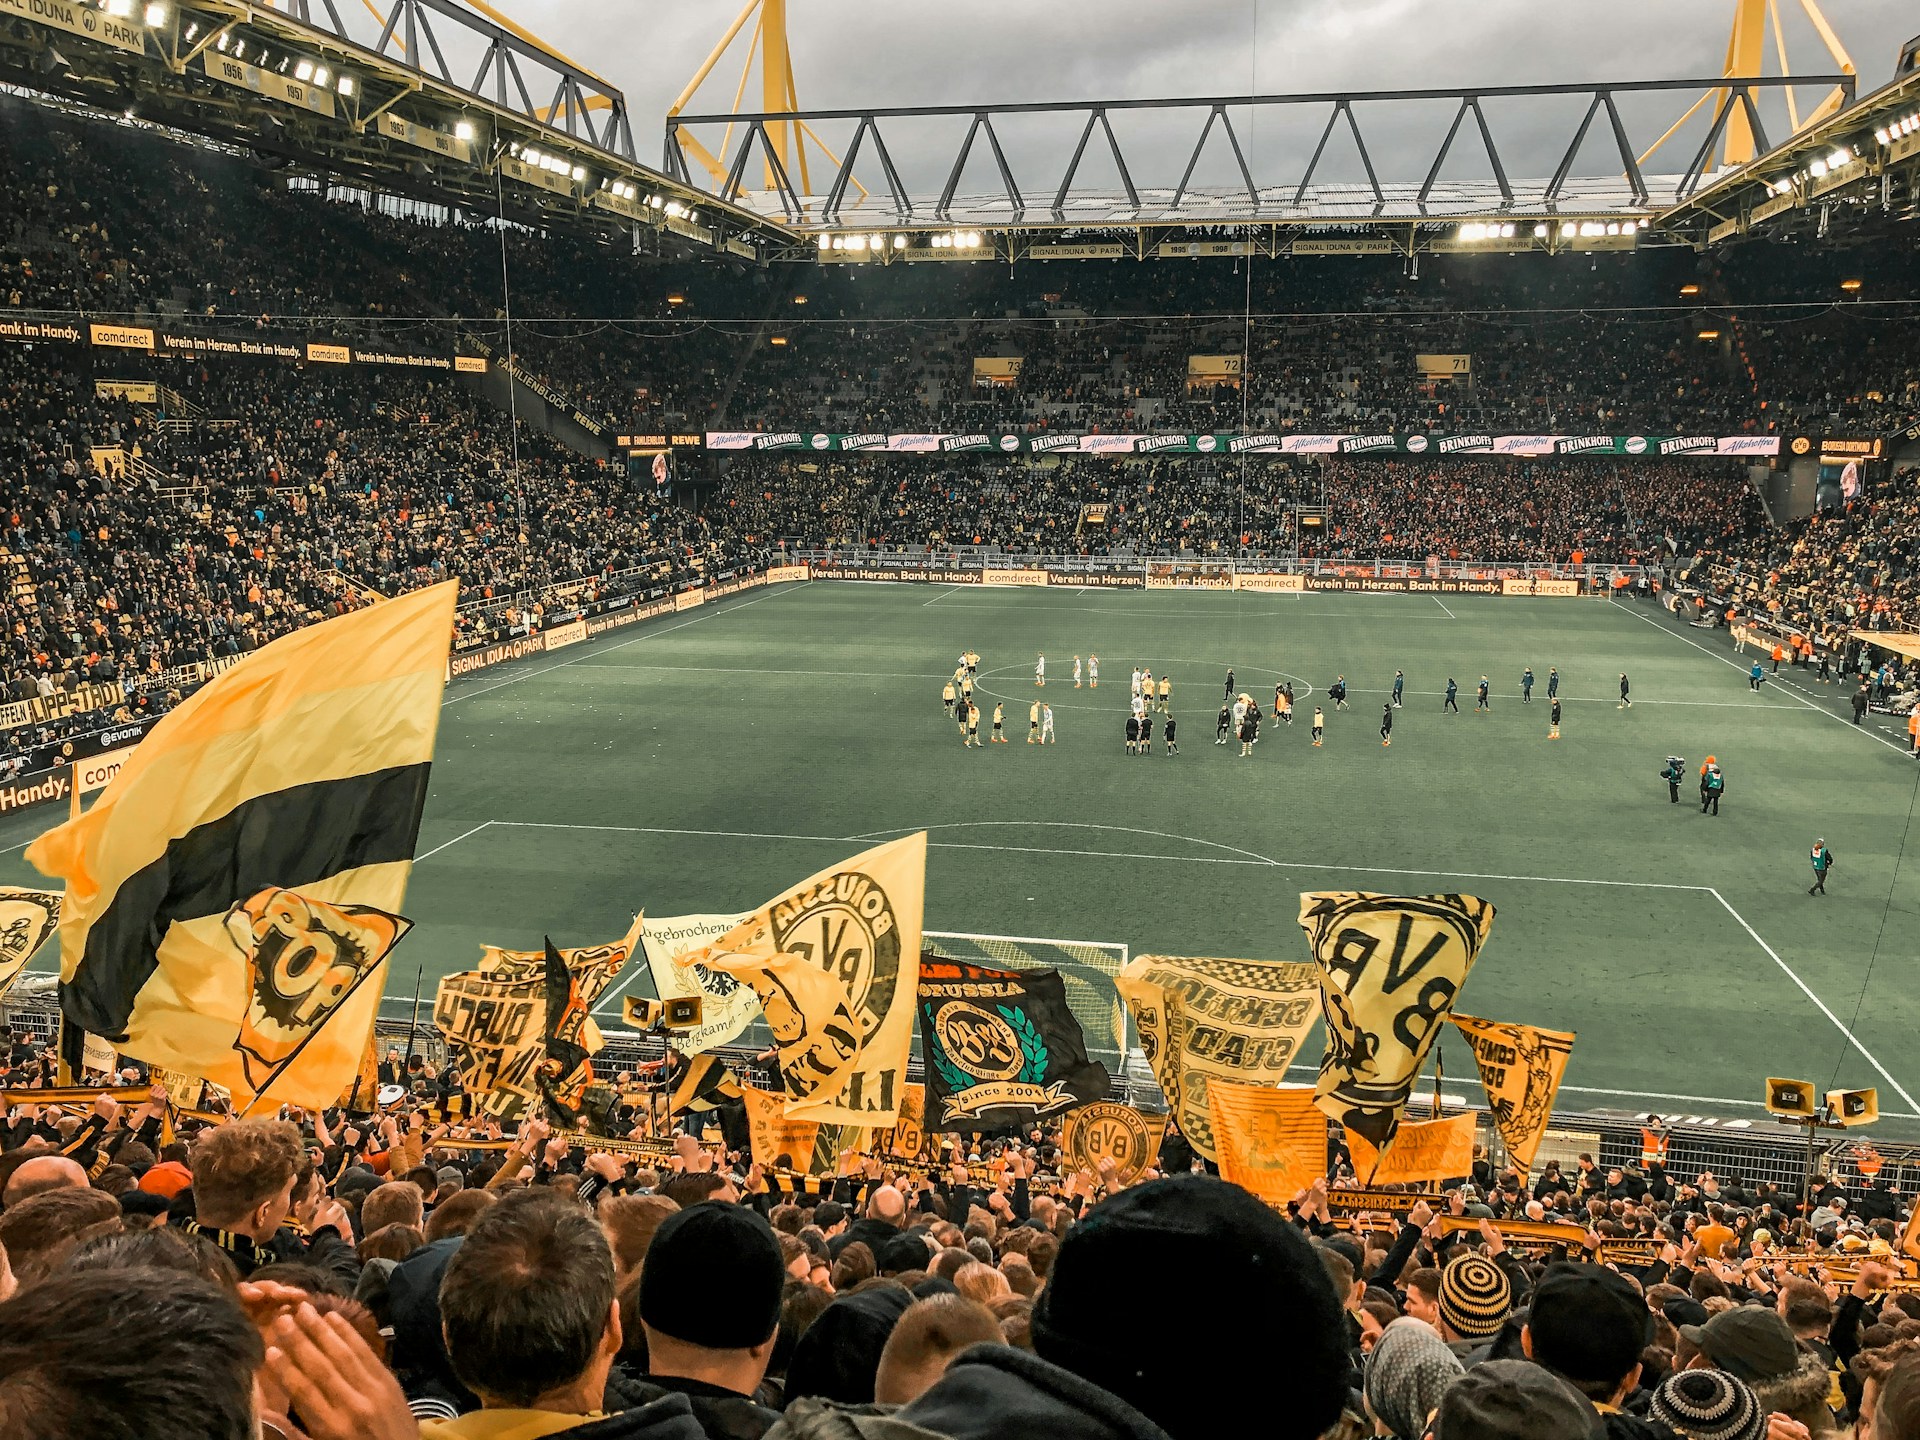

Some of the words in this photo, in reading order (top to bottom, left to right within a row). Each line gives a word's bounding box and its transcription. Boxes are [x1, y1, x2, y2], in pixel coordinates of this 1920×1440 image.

[29, 0, 75, 26] IDUNA
[104, 21, 141, 47] PARK
[222, 61, 243, 82] 1956
[286, 84, 303, 102] 1957
[1032, 248, 1061, 256] SIGNAL
[1100, 247, 1121, 255] PARK
[1295, 243, 1325, 252] SIGNAL
[1326, 243, 1351, 251] IDUNA
[1367, 242, 1389, 250] PARK
[1507, 241, 1529, 249] PARK
[907, 250, 935, 258] SIGNAL
[935, 250, 958, 258] IDUNA
[972, 249, 993, 258] PARK
[23, 322, 39, 336] im
[41, 324, 81, 343] Handy.
[97, 331, 148, 346] comdirect
[163, 334, 193, 348] Verein
[194, 337, 205, 349] im
[207, 338, 240, 353] Herzen.
[241, 341, 263, 354] Bank
[263, 343, 273, 354] im
[274, 344, 301, 359] Handy.
[311, 349, 346, 361] comdirect
[355, 351, 375, 363] Verein
[376, 353, 384, 363] im
[385, 354, 408, 365] Herzen.
[408, 355, 423, 366] Bank
[423, 357, 431, 367] im
[431, 357, 451, 370] Handy.
[457, 361, 483, 371] comdirect
[1008, 361, 1021, 372] 73
[1224, 360, 1239, 371] 72
[1452, 359, 1467, 370] 71
[464, 333, 492, 358] REWE
[497, 355, 568, 413] FAMILIENBLOCK
[572, 411, 602, 436] REWE
[147, 393, 155, 401] 27
[672, 435, 701, 446] REWE
[1794, 439, 1807, 449] BVB
[113, 455, 121, 463] 26
[768, 570, 802, 582] comdirect
[811, 568, 843, 580] Verein
[845, 569, 857, 580] im
[859, 570, 899, 581] Herzen.
[901, 570, 927, 581] Bank
[929, 571, 942, 582] im
[944, 571, 982, 584] Handy.
[988, 573, 1042, 583] comdirect
[1050, 574, 1084, 585] Verein
[1086, 574, 1100, 585] im
[1102, 575, 1143, 586] Herzen.
[1147, 576, 1174, 586] Bank
[1192, 575, 1231, 587] Handy.
[1240, 577, 1297, 588] comdirect
[1306, 578, 1343, 589] Verein
[1345, 578, 1360, 590] im
[1362, 580, 1407, 591] Herzen.
[1409, 581, 1440, 592] Bank
[1442, 581, 1458, 592] im
[1459, 582, 1501, 595] Handy.
[678, 592, 702, 608] comdirect
[586, 620, 607, 635] Verein
[606, 616, 615, 630] im
[614, 613, 637, 627] Herzen.
[637, 606, 652, 621] Bank
[650, 604, 659, 617] im
[549, 628, 583, 647] comdirect
[451, 653, 486, 676] SIGNAL
[522, 636, 544, 655] PARK
[30, 682, 122, 722] LIPPSTADT
[110, 726, 143, 743] EVONIK
[0, 776, 70, 811] Handy.
[918, 982, 1026, 999] ORUSSIA
[961, 1088, 1001, 1104] since
[1007, 1087, 1042, 1098] 2004
